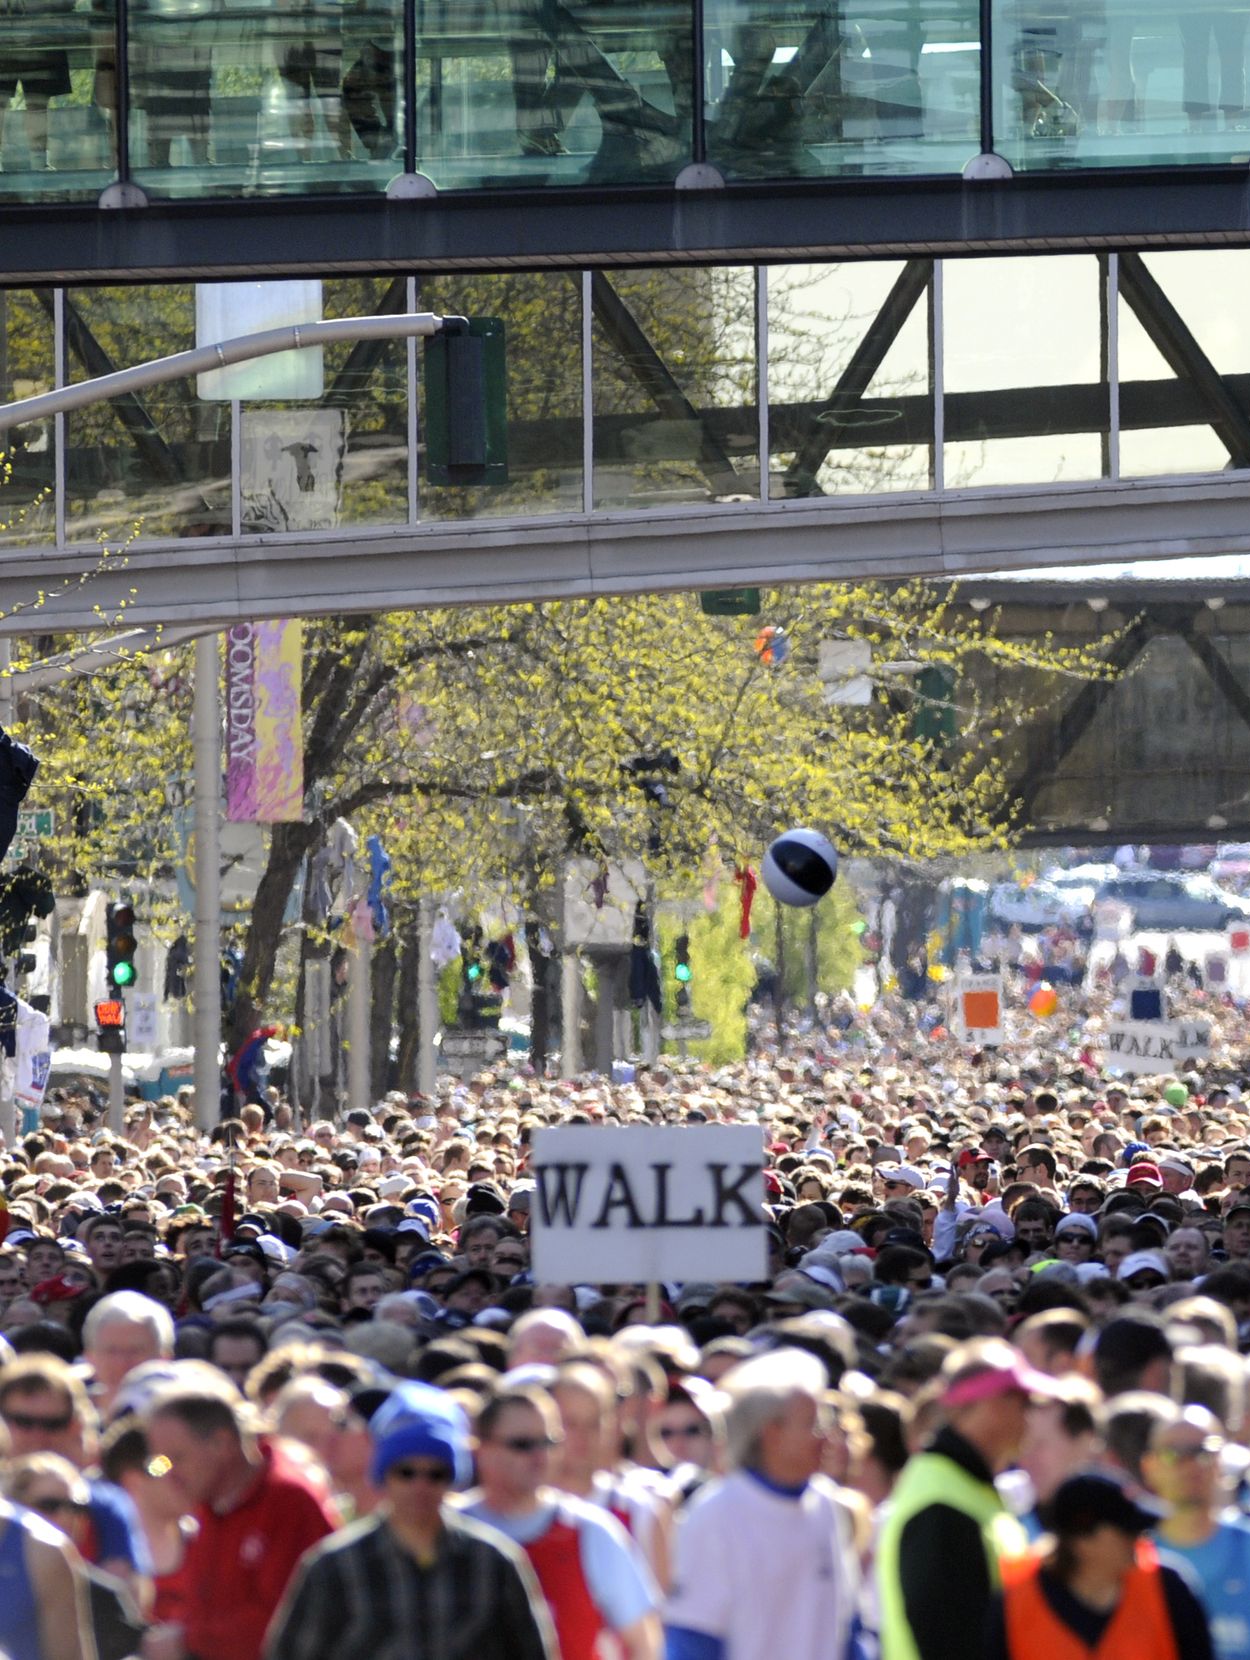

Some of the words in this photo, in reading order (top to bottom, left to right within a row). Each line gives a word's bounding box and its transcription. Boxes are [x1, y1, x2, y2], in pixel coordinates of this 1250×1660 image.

[229, 623, 254, 767] OOMSDAY
[1109, 1033, 1173, 1059] WALK
[534, 1162, 764, 1229] WALK
